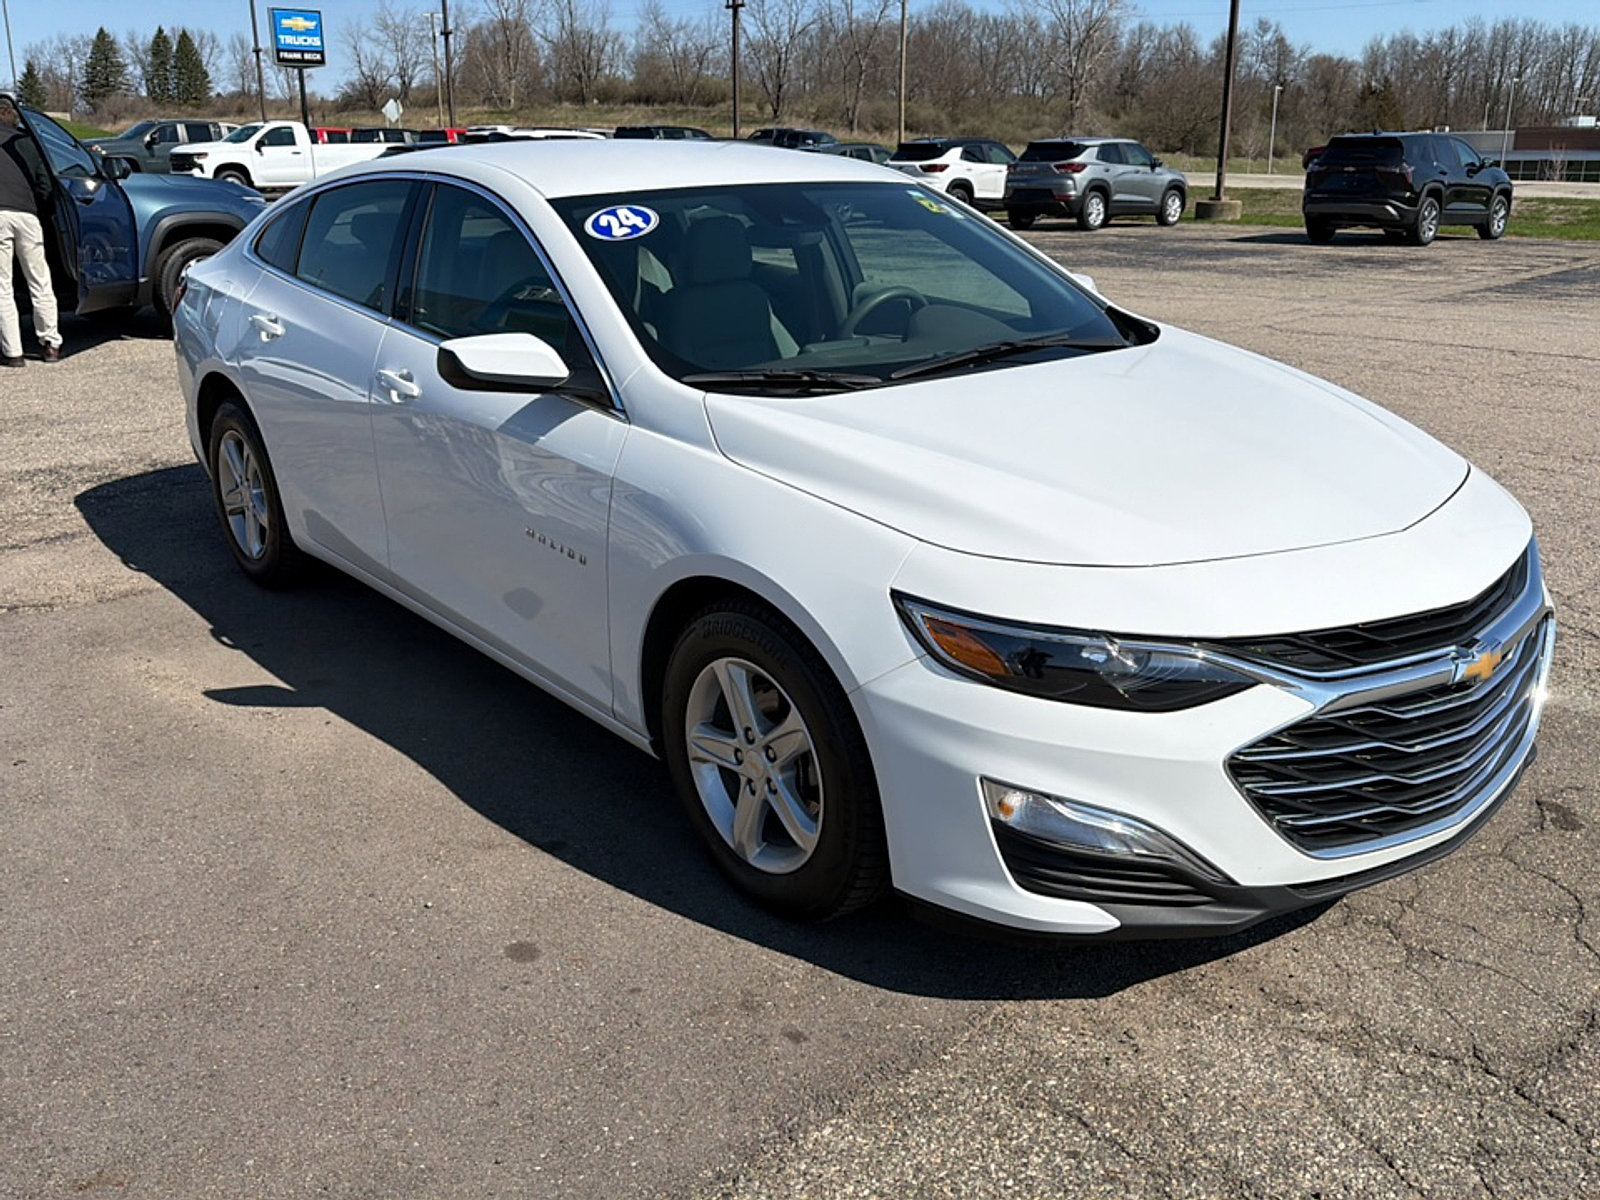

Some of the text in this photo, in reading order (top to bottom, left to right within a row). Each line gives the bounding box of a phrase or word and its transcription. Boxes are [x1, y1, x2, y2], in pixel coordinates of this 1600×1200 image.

[278, 35, 321, 47] TRUCKS
[599, 208, 648, 237] 24
[525, 526, 587, 566] MALIBU
